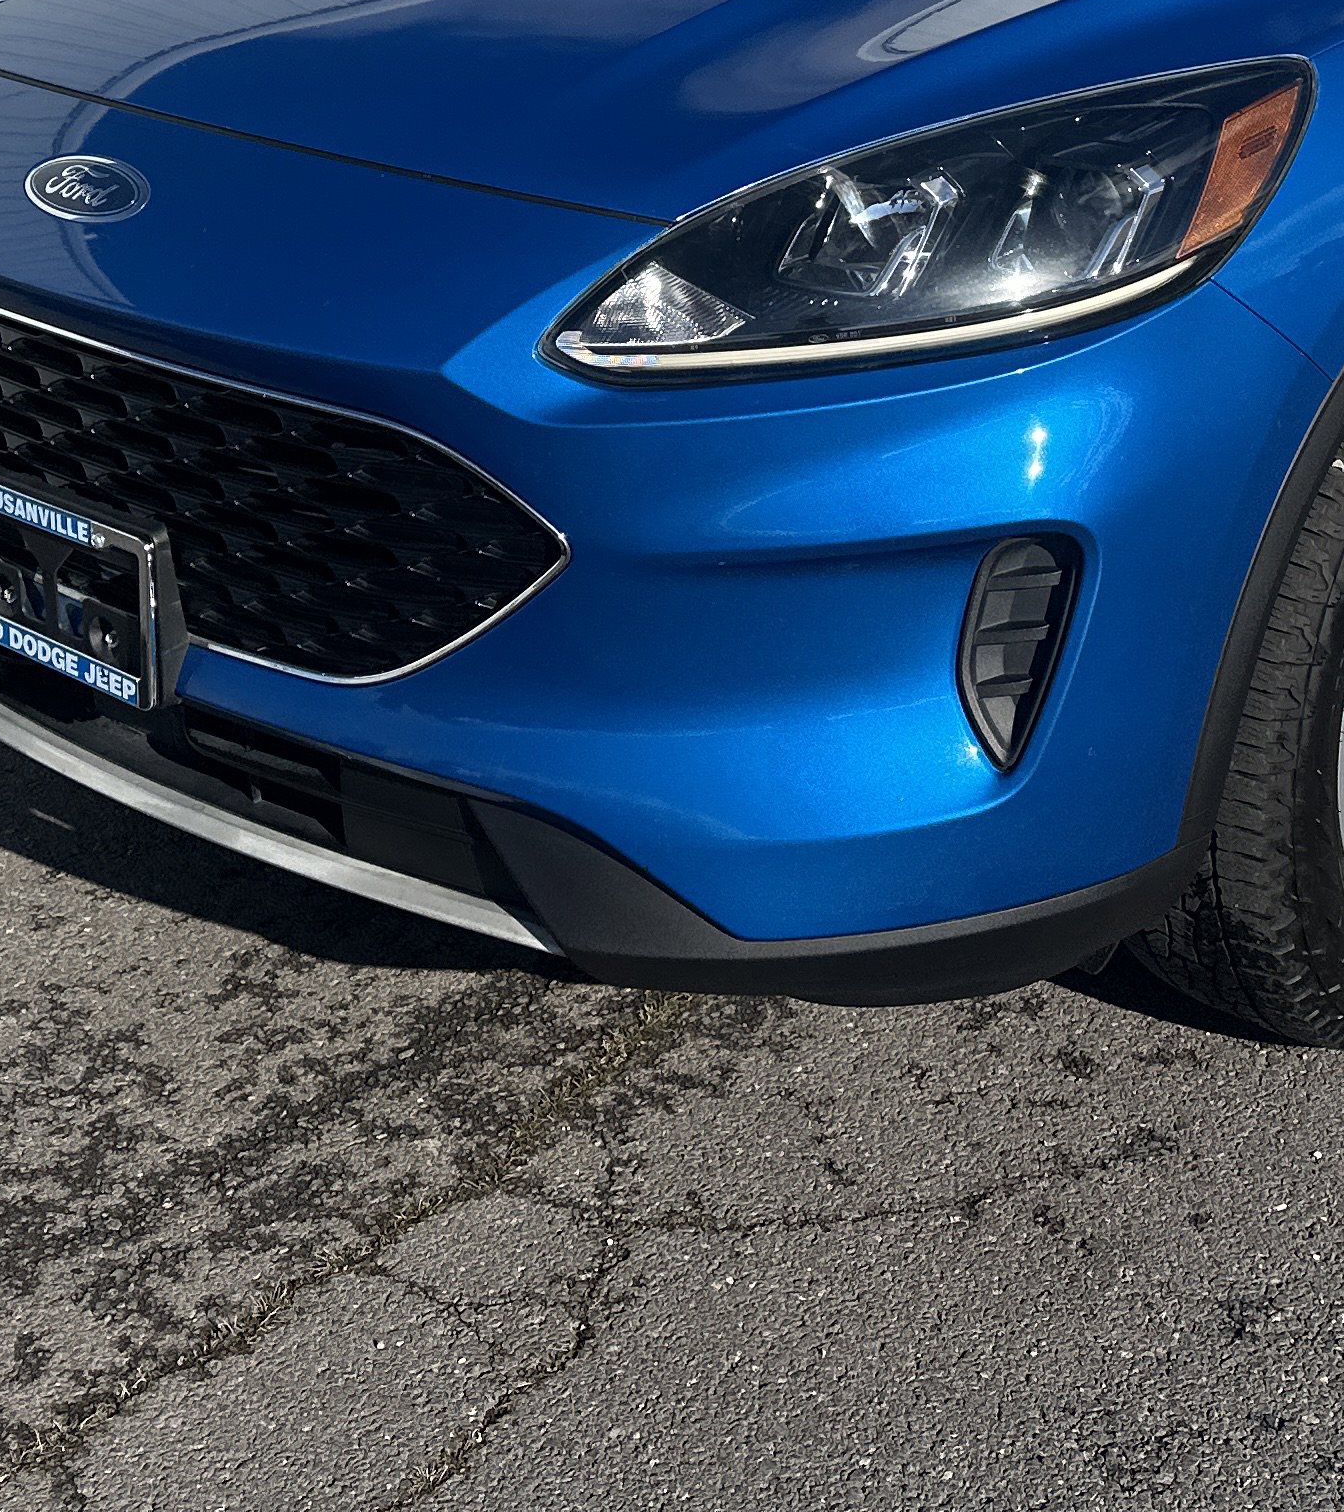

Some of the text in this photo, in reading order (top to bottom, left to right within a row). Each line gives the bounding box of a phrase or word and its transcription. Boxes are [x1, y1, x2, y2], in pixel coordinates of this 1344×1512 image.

[45, 164, 119, 207] Ford
[9, 626, 80, 678] DODGE
[84, 664, 136, 701] JEEP
